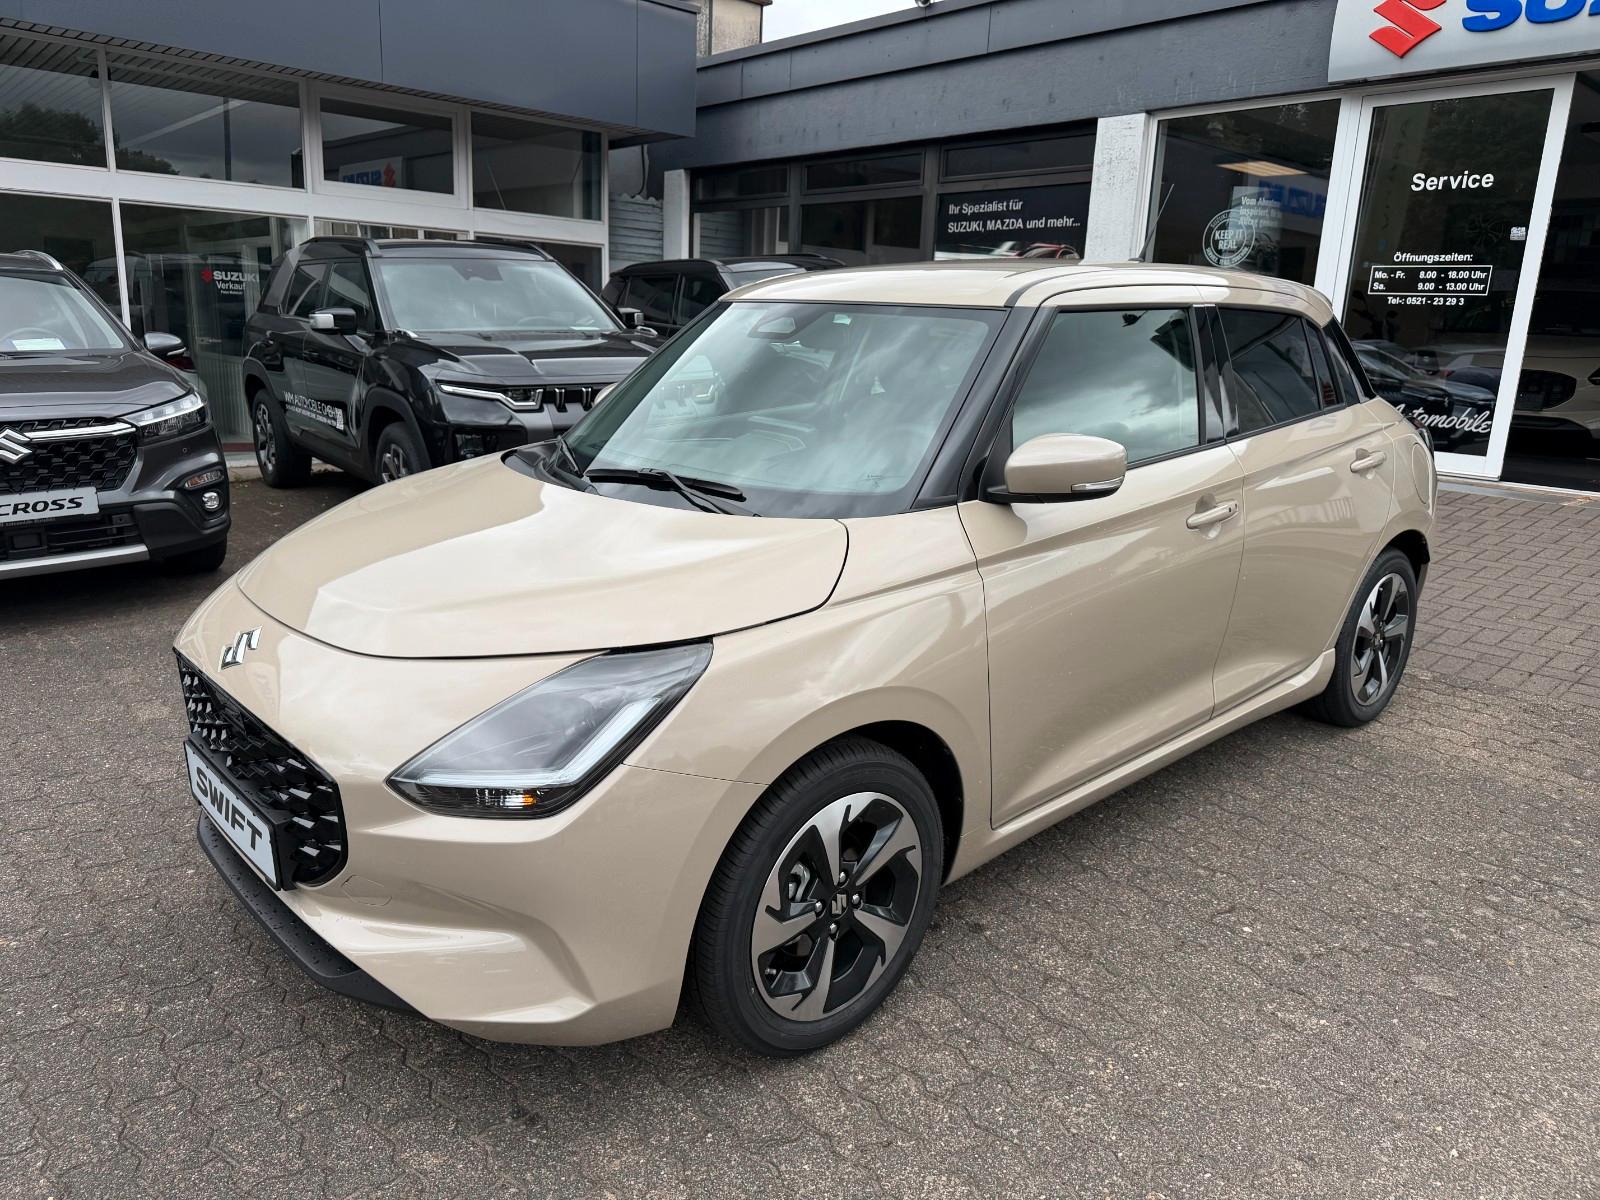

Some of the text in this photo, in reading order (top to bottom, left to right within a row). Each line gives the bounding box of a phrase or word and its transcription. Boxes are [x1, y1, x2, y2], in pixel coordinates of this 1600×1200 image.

[1411, 170, 1494, 191] Service
[949, 199, 1023, 215] Ihr Spezialist für
[948, 215, 1080, 233] SUZUKI, MAZDA und mehr...
[1215, 229, 1234, 240] KEEP
[1218, 239, 1237, 250] REAL
[1393, 251, 1473, 263] Öffnungszeiten:
[213, 270, 259, 283] SUZUKI
[1374, 271, 1388, 279] Mo.
[1396, 271, 1406, 279] Fr.
[1419, 270, 1437, 279] 8.00
[1448, 270, 1469, 279] 18.00
[1471, 271, 1487, 279] Uhr
[1373, 282, 1386, 290] Sa.
[1417, 282, 1435, 290] 9.00
[1446, 282, 1467, 290] 13.00
[1469, 283, 1485, 291] Uhr
[1406, 297, 1426, 305] 0521
[1433, 297, 1444, 305] 23
[1446, 297, 1457, 306] 29
[1458, 297, 1465, 306] 3
[196, 766, 263, 851] SWIFT
